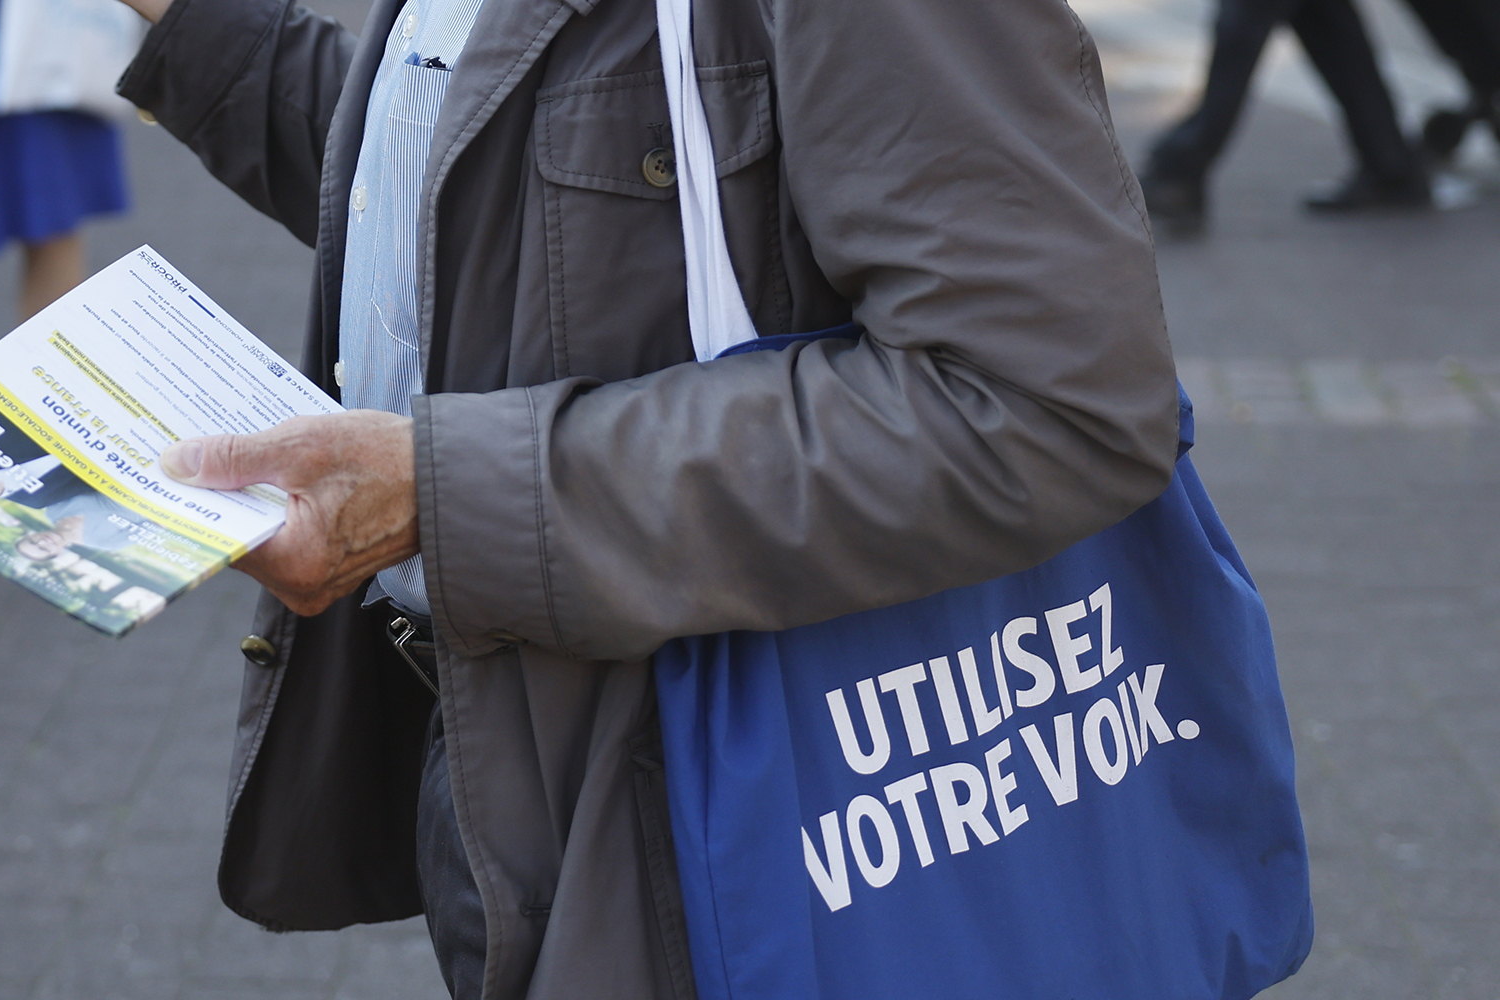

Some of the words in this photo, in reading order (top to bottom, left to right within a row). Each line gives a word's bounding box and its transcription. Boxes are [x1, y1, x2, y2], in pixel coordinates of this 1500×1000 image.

[126, 268, 159, 296] renommée
[130, 298, 144, 309] par
[146, 293, 159, 305] nos
[156, 303, 167, 311] de
[80, 302, 101, 320] toutes
[108, 307, 122, 319] son
[140, 307, 167, 330] dominée
[168, 304, 205, 336] économique
[53, 331, 70, 345] belle
[126, 323, 141, 335] tout
[163, 309, 211, 349] fonctionnement
[50, 340, 77, 362] majorité
[67, 343, 86, 359] notre
[119, 337, 142, 356] sociale
[139, 354, 155, 367] paix
[201, 360, 212, 369] de
[213, 352, 237, 371] bloque
[73, 360, 101, 383] nouvelle
[158, 371, 174, 384] pour
[168, 361, 209, 396] démocratique
[209, 367, 235, 389] addition
[235, 362, 278, 397] profondément
[27, 363, 92, 419] France
[97, 381, 112, 392] une
[171, 383, 190, 398] grave
[232, 387, 246, 399] une
[285, 376, 330, 414] NAISSANCE
[109, 391, 143, 418] construire
[124, 393, 138, 404] qui
[187, 397, 212, 418] menace
[207, 395, 223, 407] plan
[134, 402, 152, 416] ceux
[227, 412, 238, 421] sur
[250, 404, 271, 422] NUPES
[271, 402, 291, 418] ultiplie
[42, 396, 106, 450] d'union
[84, 415, 110, 435] la
[210, 417, 223, 428] une
[234, 408, 261, 432] nomique.
[103, 430, 155, 468] pour
[126, 427, 161, 457] sbourgeois,
[50, 440, 89, 470] GAUCHE
[85, 468, 101, 479] LA
[106, 452, 181, 502] majorité
[184, 502, 221, 521] Une
[104, 512, 167, 544] KELLER
[171, 517, 206, 535] DROITE
[205, 532, 220, 540] LA
[125, 532, 199, 571] Fabienne
[825, 582, 1125, 776] UTILISEZ
[800, 737, 1031, 913] VOTRE
[1018, 664, 1201, 807] VOIX.
